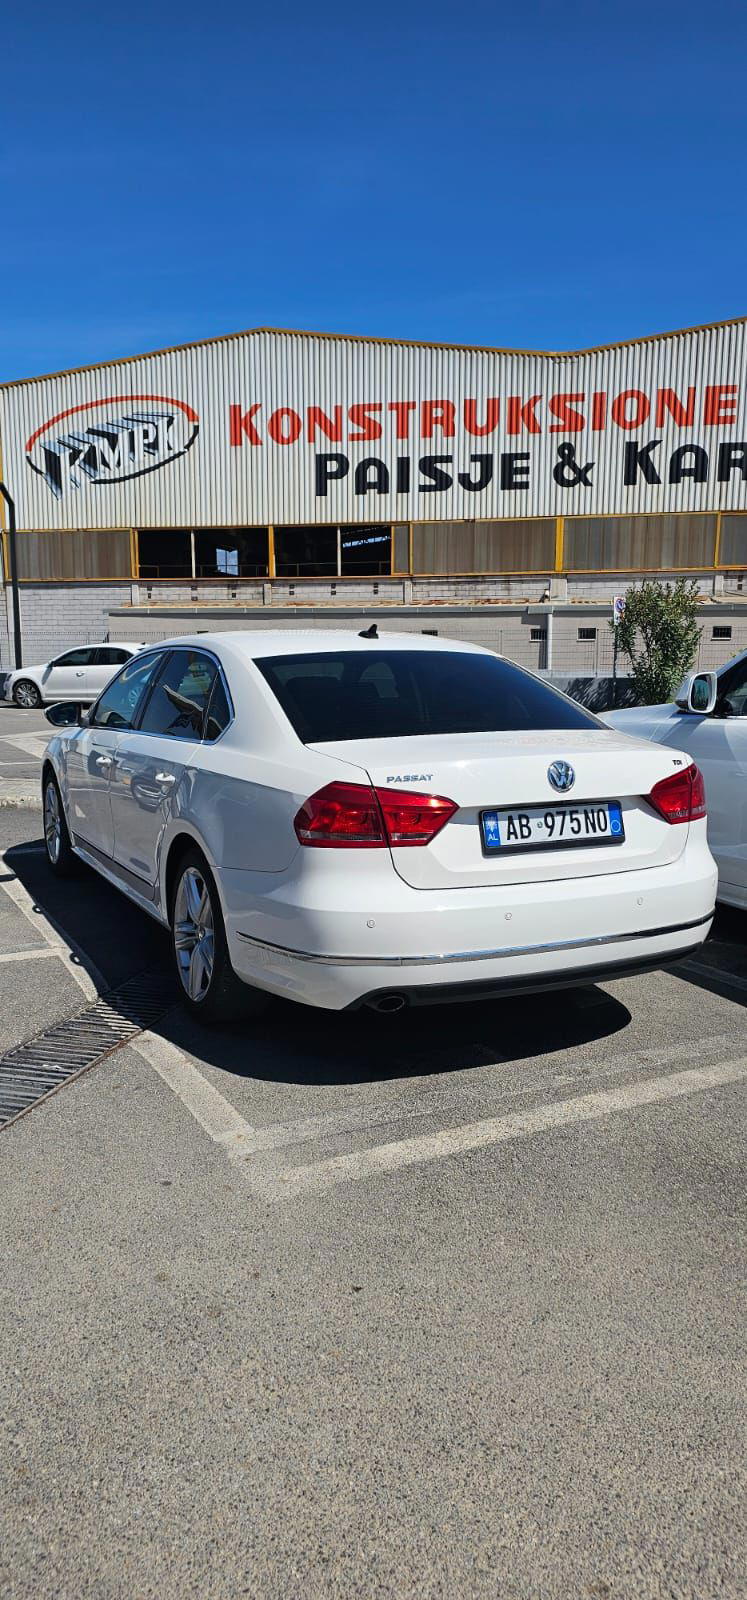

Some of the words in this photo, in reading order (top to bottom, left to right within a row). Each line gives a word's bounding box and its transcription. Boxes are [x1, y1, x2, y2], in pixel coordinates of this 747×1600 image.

[229, 385, 738, 447] KONSTRUKSIONE
[314, 451, 530, 496] PAISJE
[552, 441, 595, 489] &
[624, 439, 747, 486] KAR
[386, 774, 434, 783] PASSAT
[506, 814, 532, 840] AB
